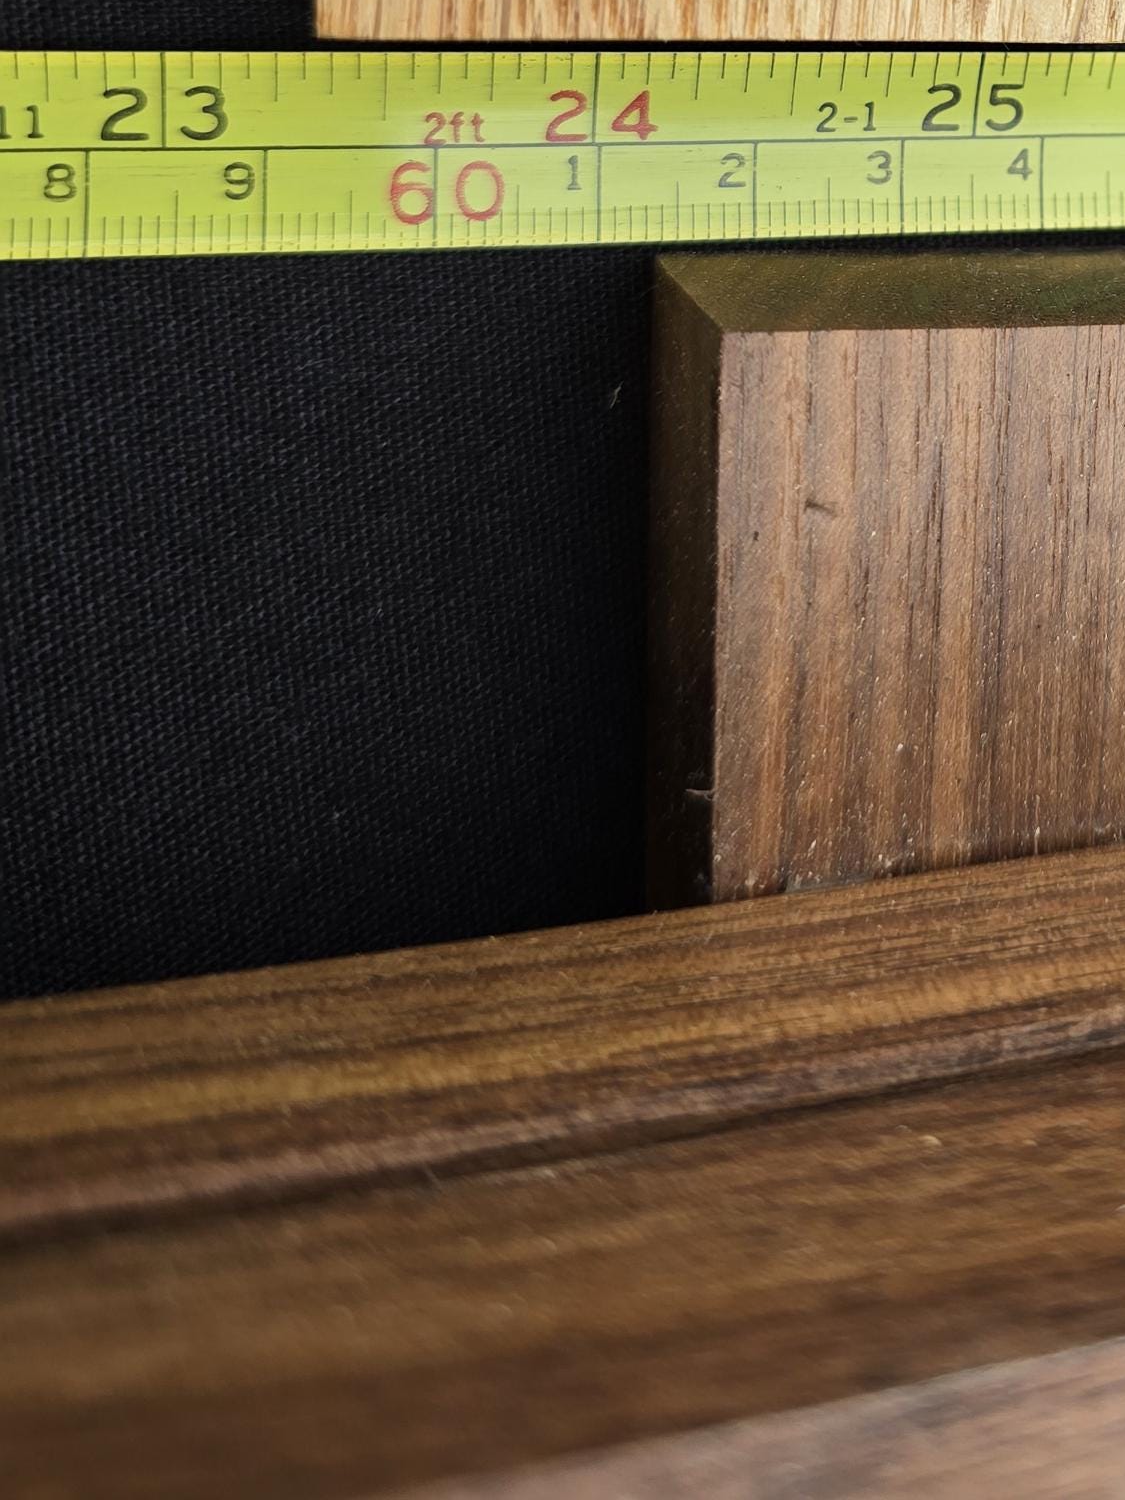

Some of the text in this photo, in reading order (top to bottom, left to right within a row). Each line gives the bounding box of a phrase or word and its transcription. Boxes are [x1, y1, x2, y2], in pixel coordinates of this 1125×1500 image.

[423, 111, 486, 145] 2ft
[817, 102, 877, 133] 2-1
[566, 155, 582, 191] 1
[718, 153, 747, 188] 2
[866, 151, 893, 184] 3
[1006, 148, 1031, 180] 4
[43, 163, 77, 203] 8
[223, 162, 256, 201] 9
